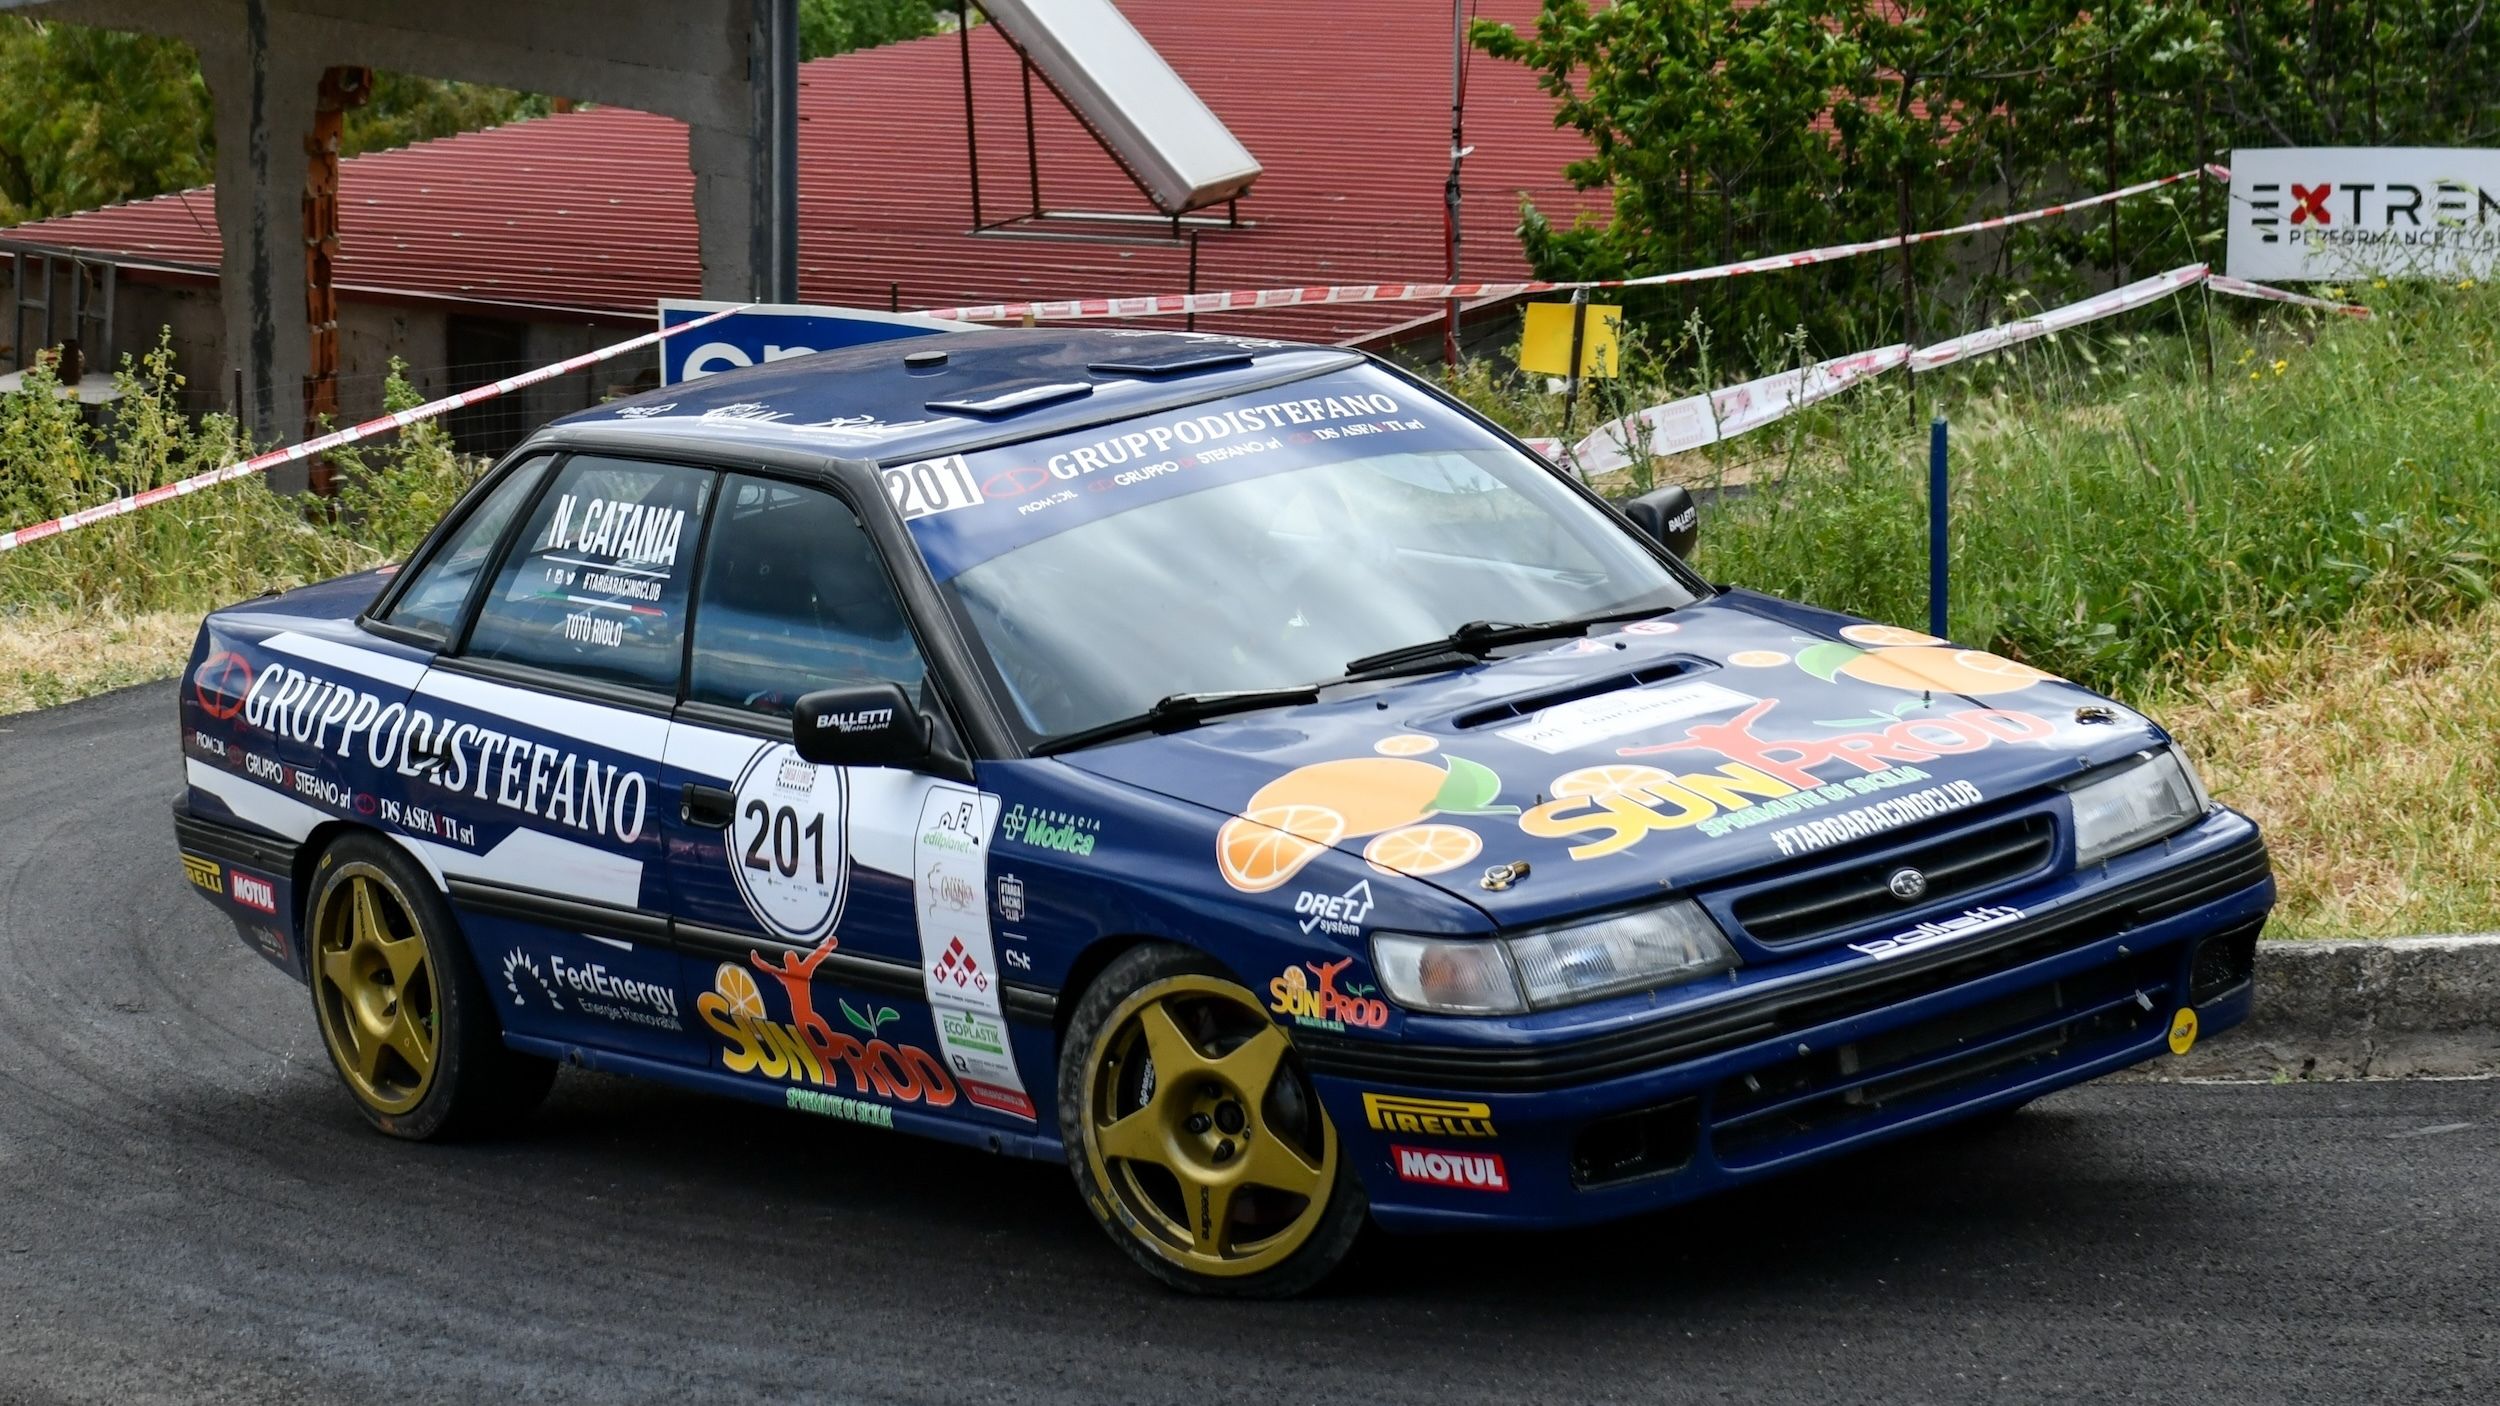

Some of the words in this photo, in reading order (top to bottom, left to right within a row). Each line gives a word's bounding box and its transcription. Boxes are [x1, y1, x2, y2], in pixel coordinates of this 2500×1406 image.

[1048, 394, 1399, 480] GRUPPODISTEFANO
[1113, 460, 1179, 487] GRUPPO
[1196, 440, 1265, 465] STEFANO
[885, 457, 975, 519] 201
[548, 494, 577, 550] N.
[577, 497, 685, 567] CATANIA
[582, 572, 662, 602] #TARGARACINGCLUB
[564, 612, 593, 642] TOTÒ
[590, 619, 623, 648] RIOLO
[816, 708, 893, 729] BALLETTI
[245, 662, 648, 844] GRUPPODISTEFANO
[245, 751, 284, 784] GRUPPO
[295, 770, 339, 805] STEFANO
[1845, 765, 1933, 795] SICILIA
[380, 797, 401, 824] DS
[1031, 807, 1101, 832] FARMACIA
[1769, 779, 1983, 857] #TARGARACINGCLUB
[745, 798, 824, 885] 201
[1022, 817, 1096, 857] Modica
[233, 876, 275, 910] MOTUL
[1295, 890, 1361, 923] DRET
[1005, 908, 1020, 923] CLUB
[1319, 919, 1361, 937] system
[551, 955, 679, 1018] FedEnergy
[943, 1019, 1001, 1045] ECOPLASTIK
[1362, 1091, 1498, 1138] PIRELLI
[1401, 1150, 1504, 1187] MOTUL
